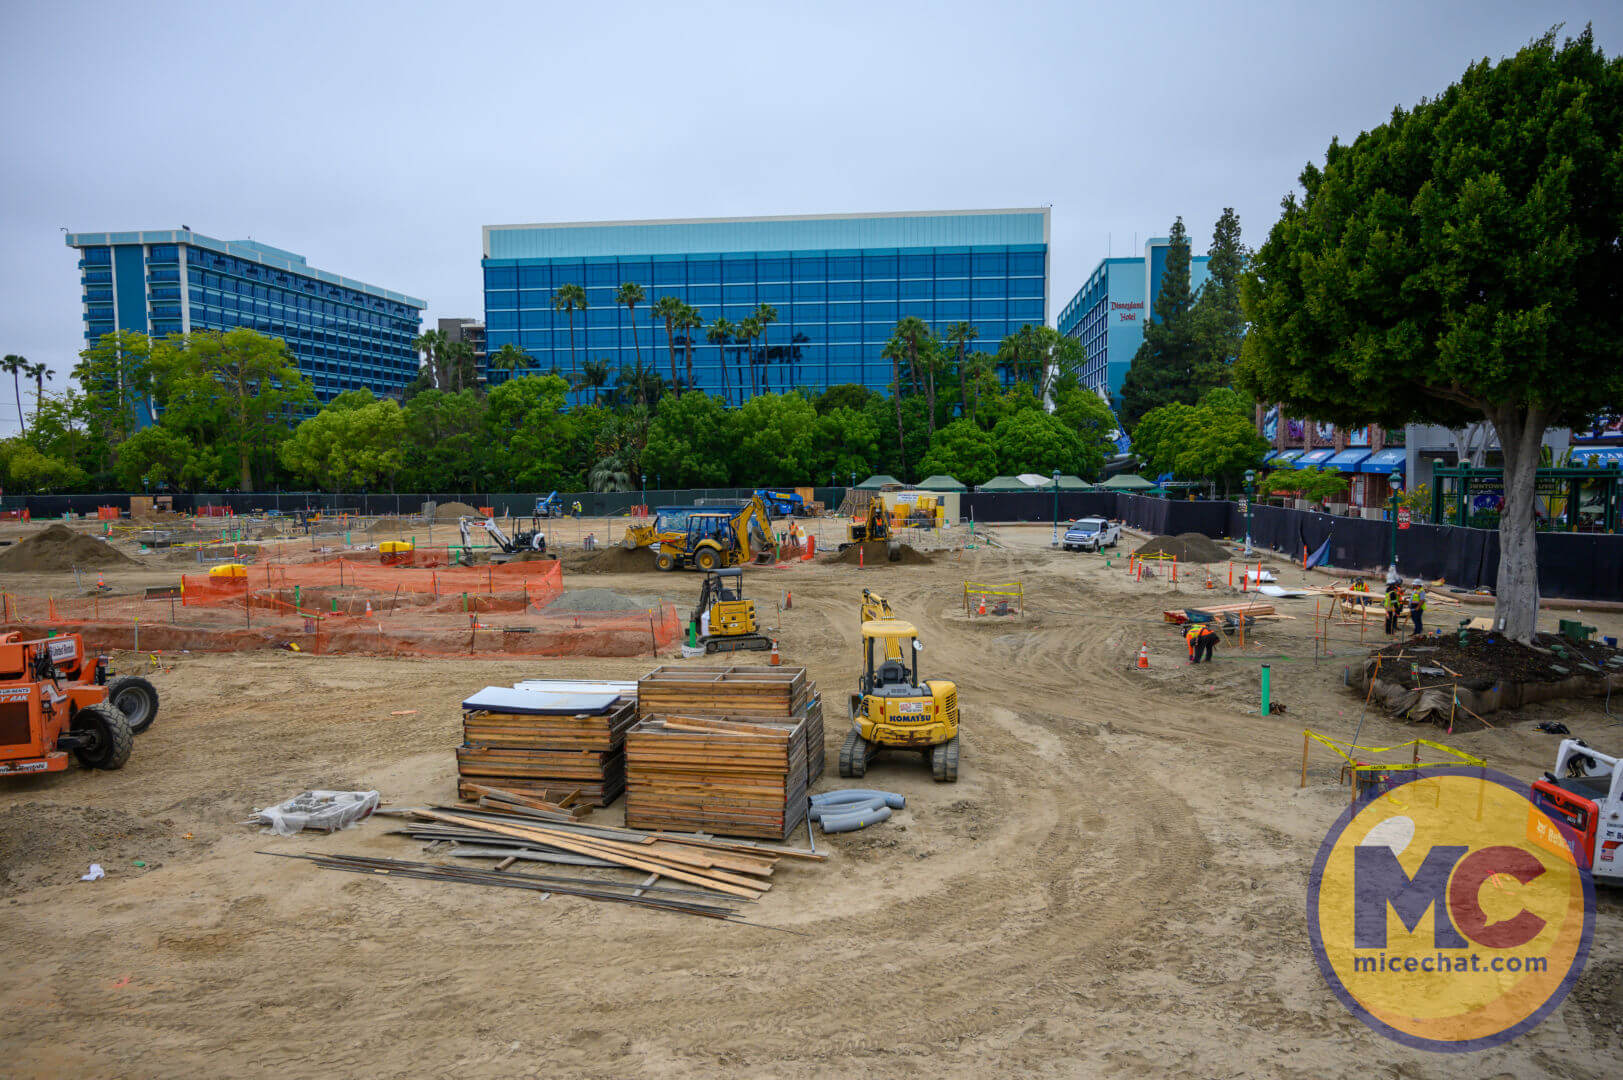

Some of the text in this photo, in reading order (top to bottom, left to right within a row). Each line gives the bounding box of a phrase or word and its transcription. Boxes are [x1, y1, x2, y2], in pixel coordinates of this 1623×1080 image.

[1111, 301, 1144, 311] Disneyland
[1120, 312, 1136, 321] Hotel
[889, 714, 931, 722] KOMATSU
